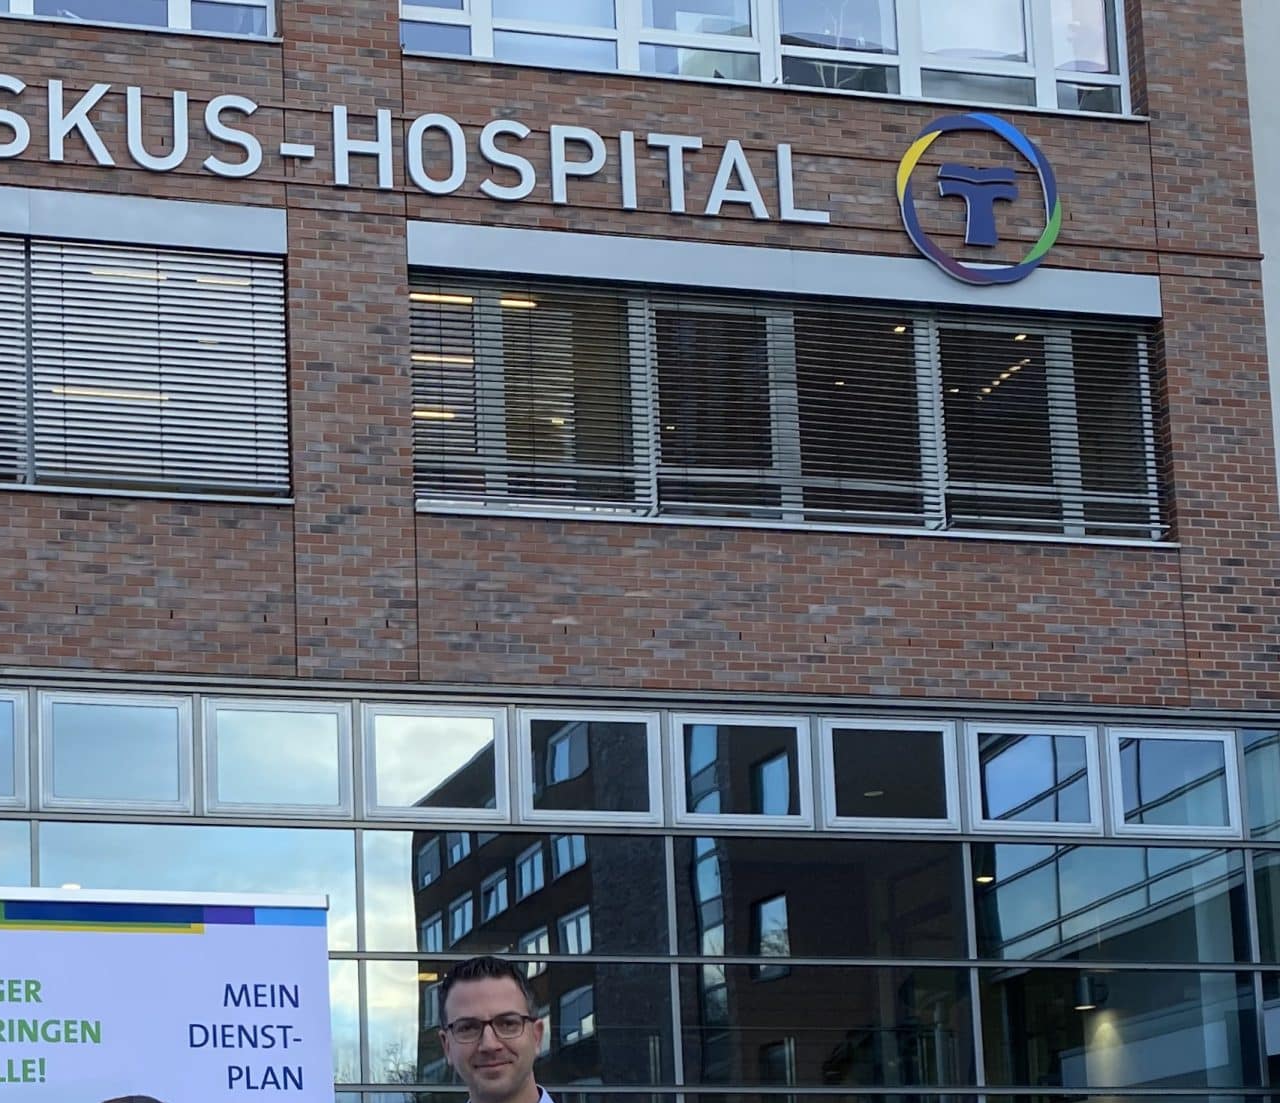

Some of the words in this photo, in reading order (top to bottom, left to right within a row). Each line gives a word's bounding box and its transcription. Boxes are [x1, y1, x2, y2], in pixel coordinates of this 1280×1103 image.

[223, 984, 300, 1009] MEIN
[189, 1023, 302, 1049] DIENST-
[228, 1066, 303, 1090] PLAN
